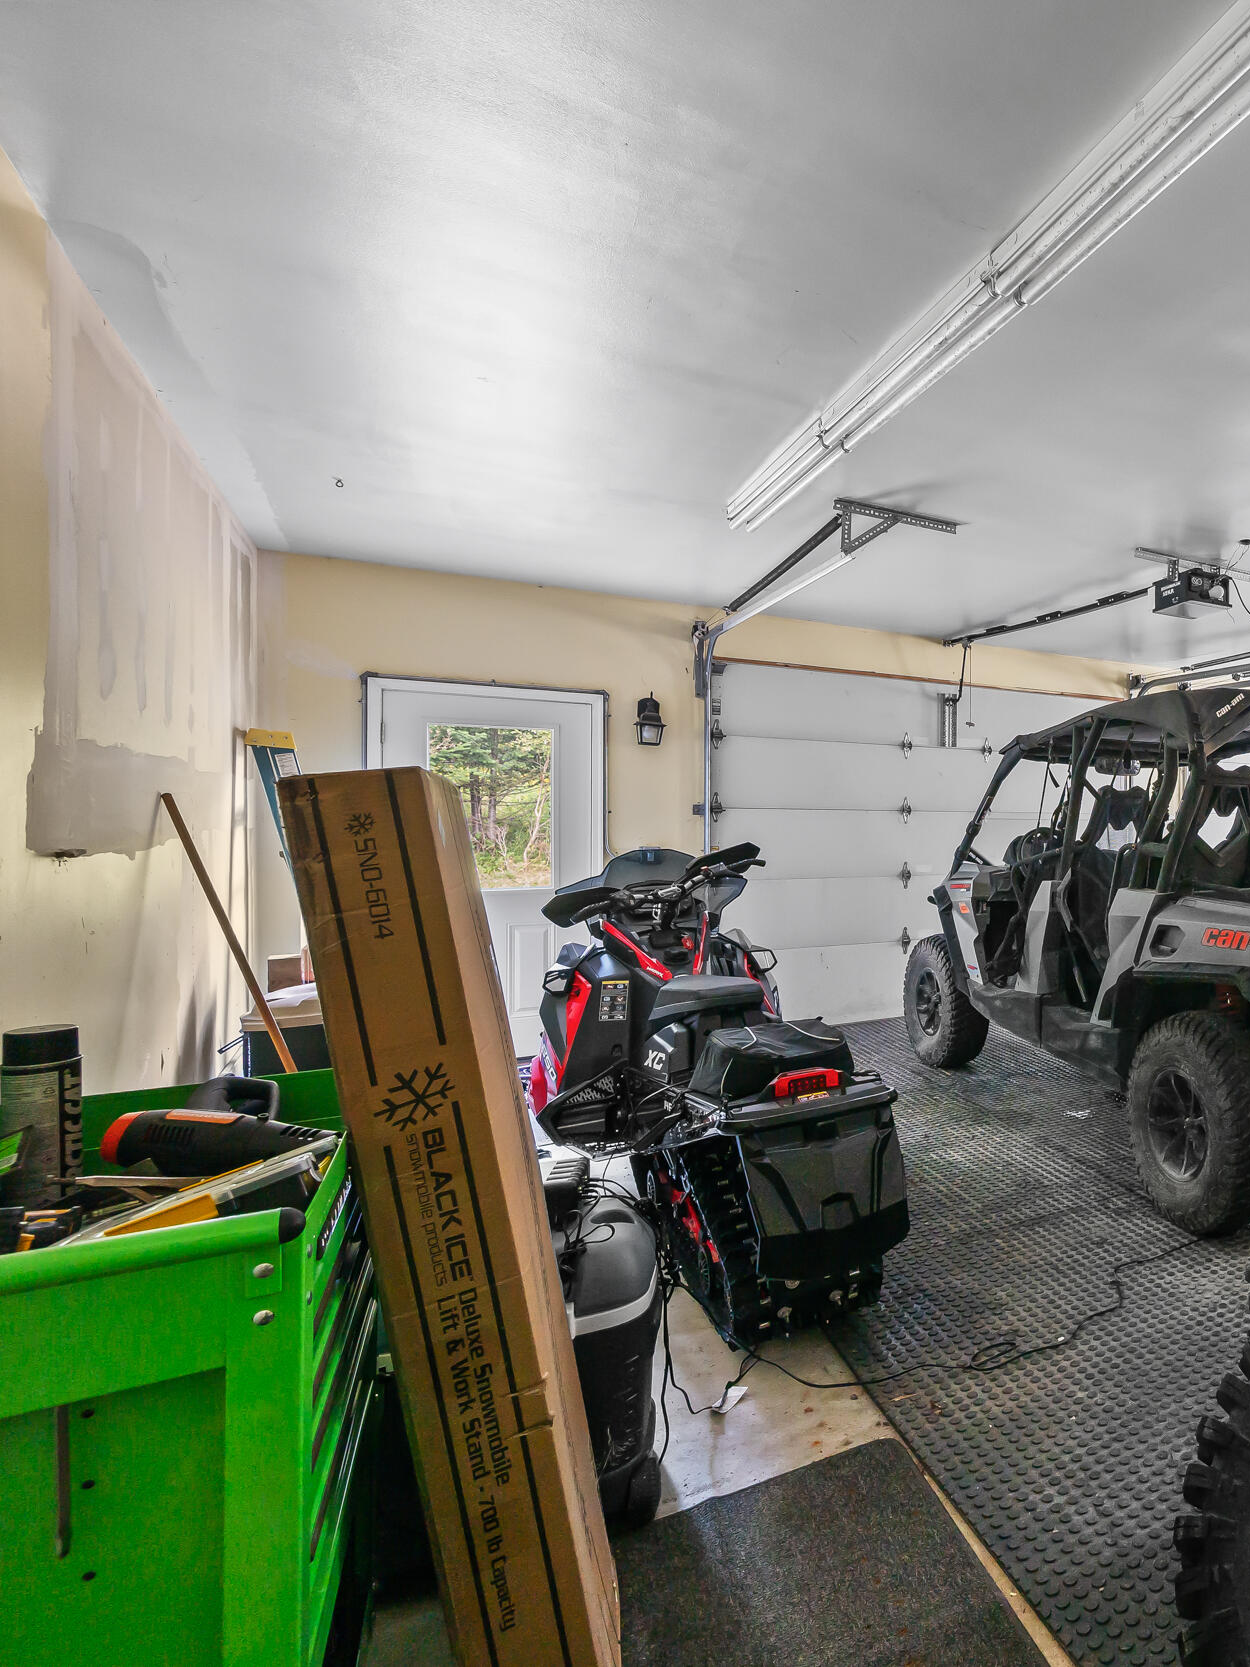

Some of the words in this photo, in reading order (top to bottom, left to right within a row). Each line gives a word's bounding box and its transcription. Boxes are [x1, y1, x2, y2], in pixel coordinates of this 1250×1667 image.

[1215, 692, 1245, 718] can-am
[643, 1049, 666, 1071] XC
[405, 1133, 433, 1220] snowmobile
[421, 1221, 449, 1288] products
[422, 1127, 463, 1232] BLACK
[444, 1232, 473, 1282] ICE
[436, 1294, 459, 1335] Lift
[445, 1337, 466, 1356] &
[450, 1357, 477, 1415] Work
[458, 1286, 485, 1361] Deluxe
[474, 1362, 513, 1487] Snowmobile
[462, 1417, 492, 1481] Stand
[478, 1494, 500, 1533] 700
[486, 1535, 504, 1554] lb
[490, 1555, 516, 1633] Capacity
